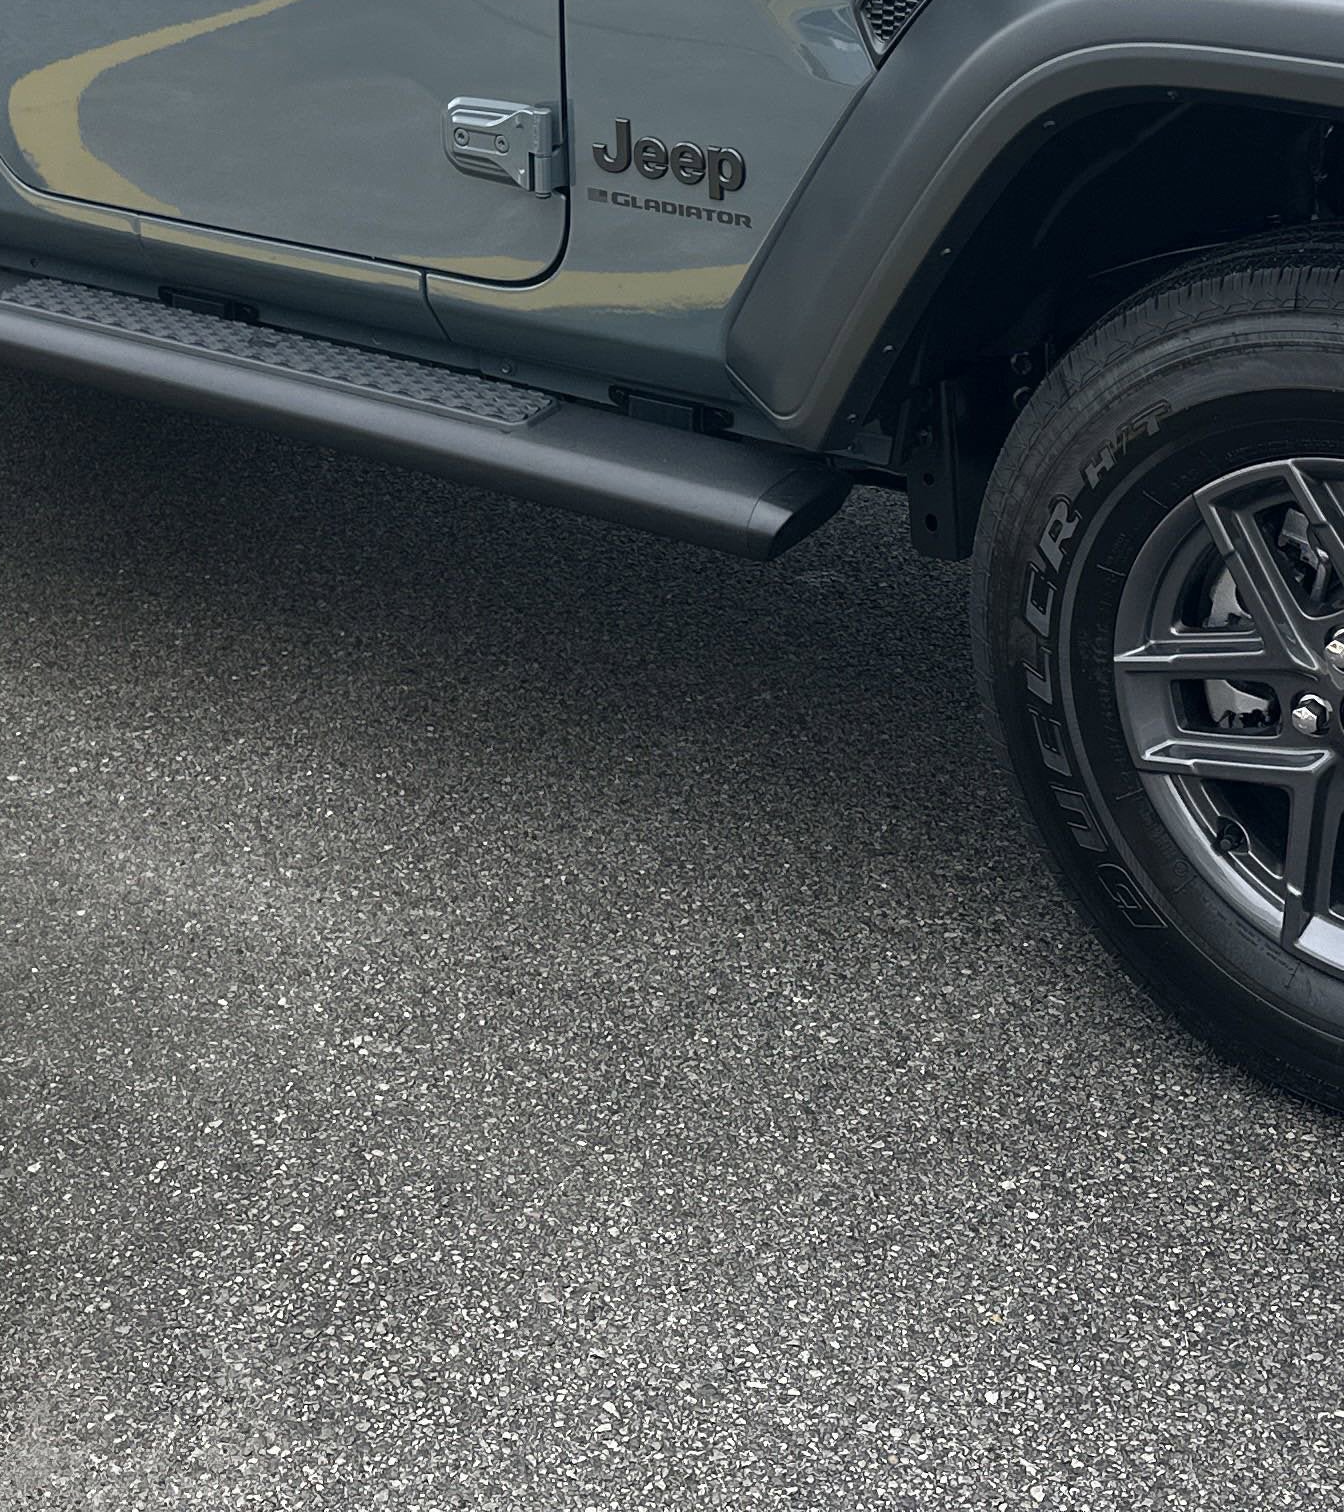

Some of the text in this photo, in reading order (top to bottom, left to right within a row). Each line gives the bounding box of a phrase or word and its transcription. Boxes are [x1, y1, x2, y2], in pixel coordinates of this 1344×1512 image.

[591, 117, 747, 201] Jeep
[611, 192, 752, 229] GLADIATOR
[1019, 494, 1168, 931] DUELER
